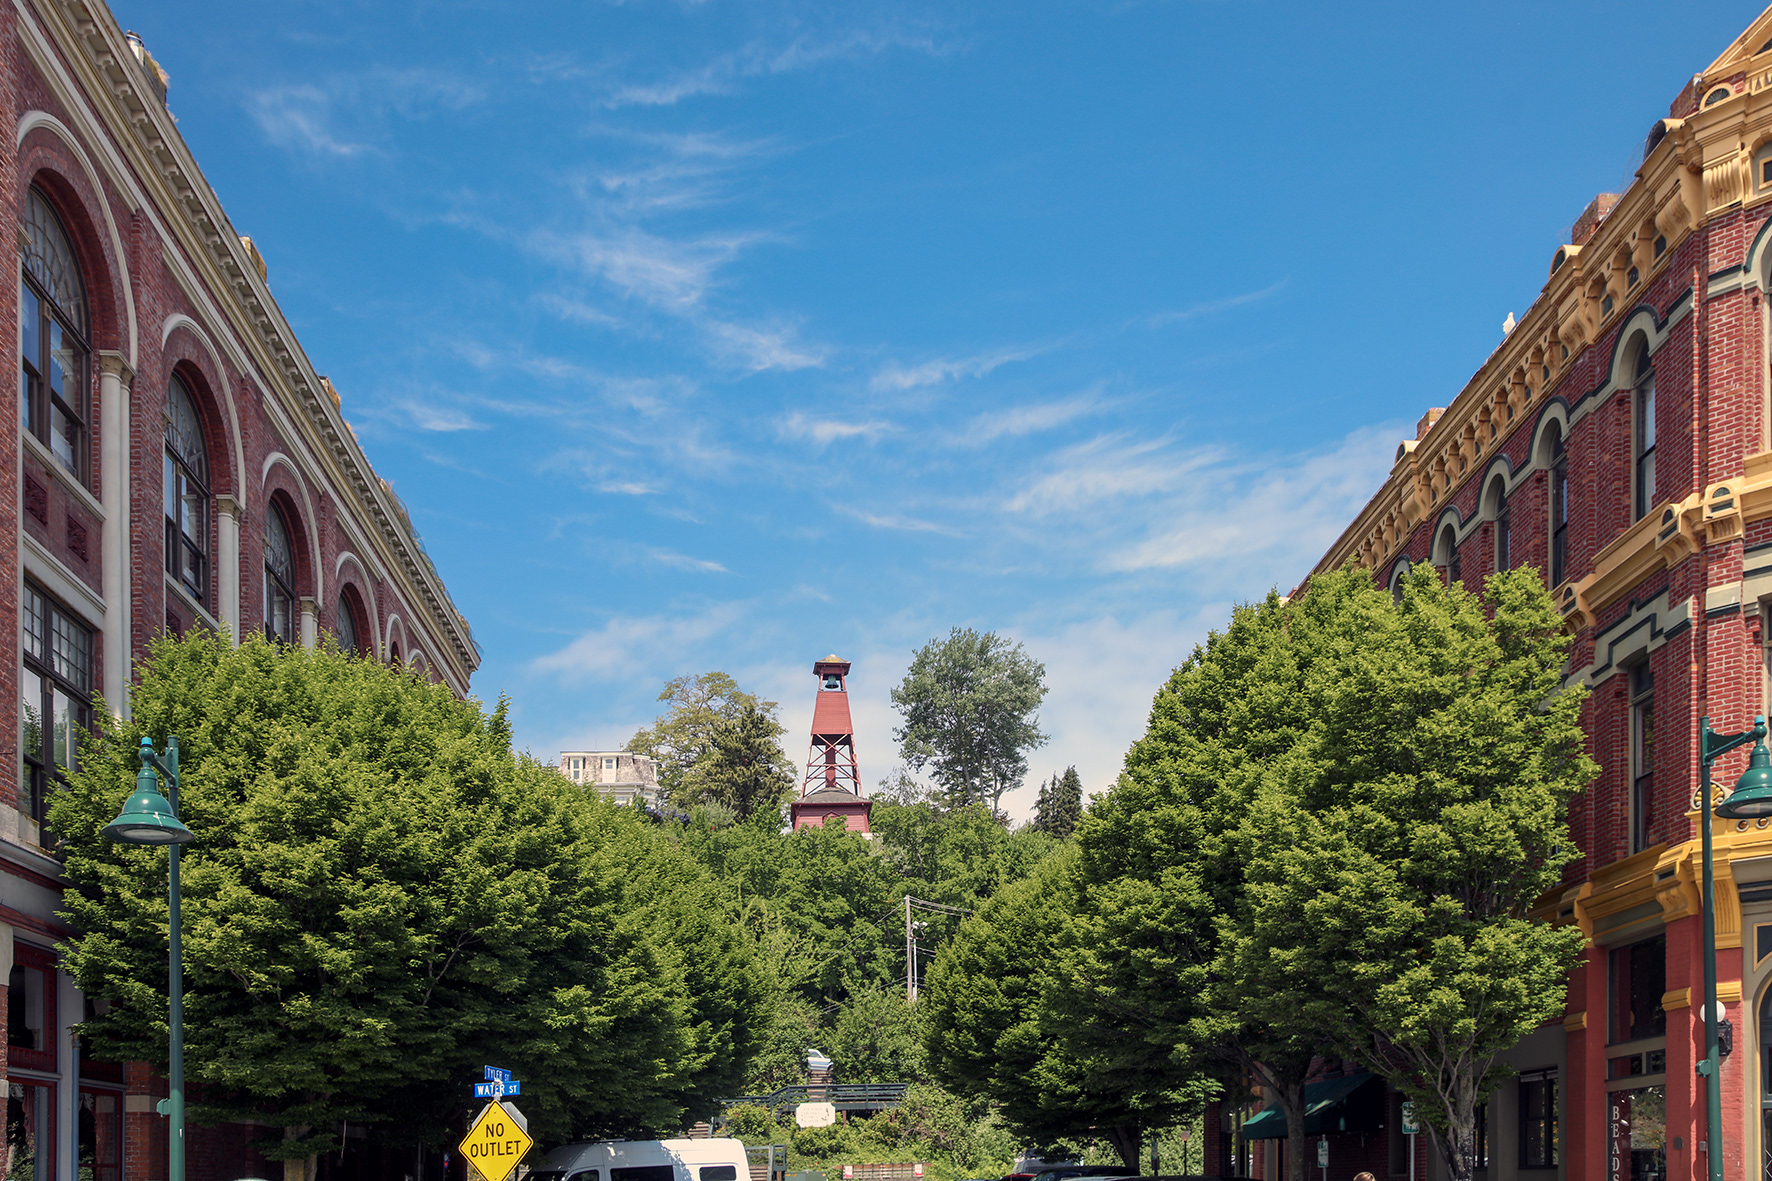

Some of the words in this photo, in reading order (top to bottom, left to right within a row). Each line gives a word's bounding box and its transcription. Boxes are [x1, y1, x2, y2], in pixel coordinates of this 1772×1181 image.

[487, 1068, 503, 1080] TYLER
[504, 1073, 510, 1082] ST
[477, 1083, 505, 1096] WATER
[509, 1085, 517, 1094] ST
[486, 1123, 504, 1138] NO
[470, 1140, 521, 1158] OUTLET
